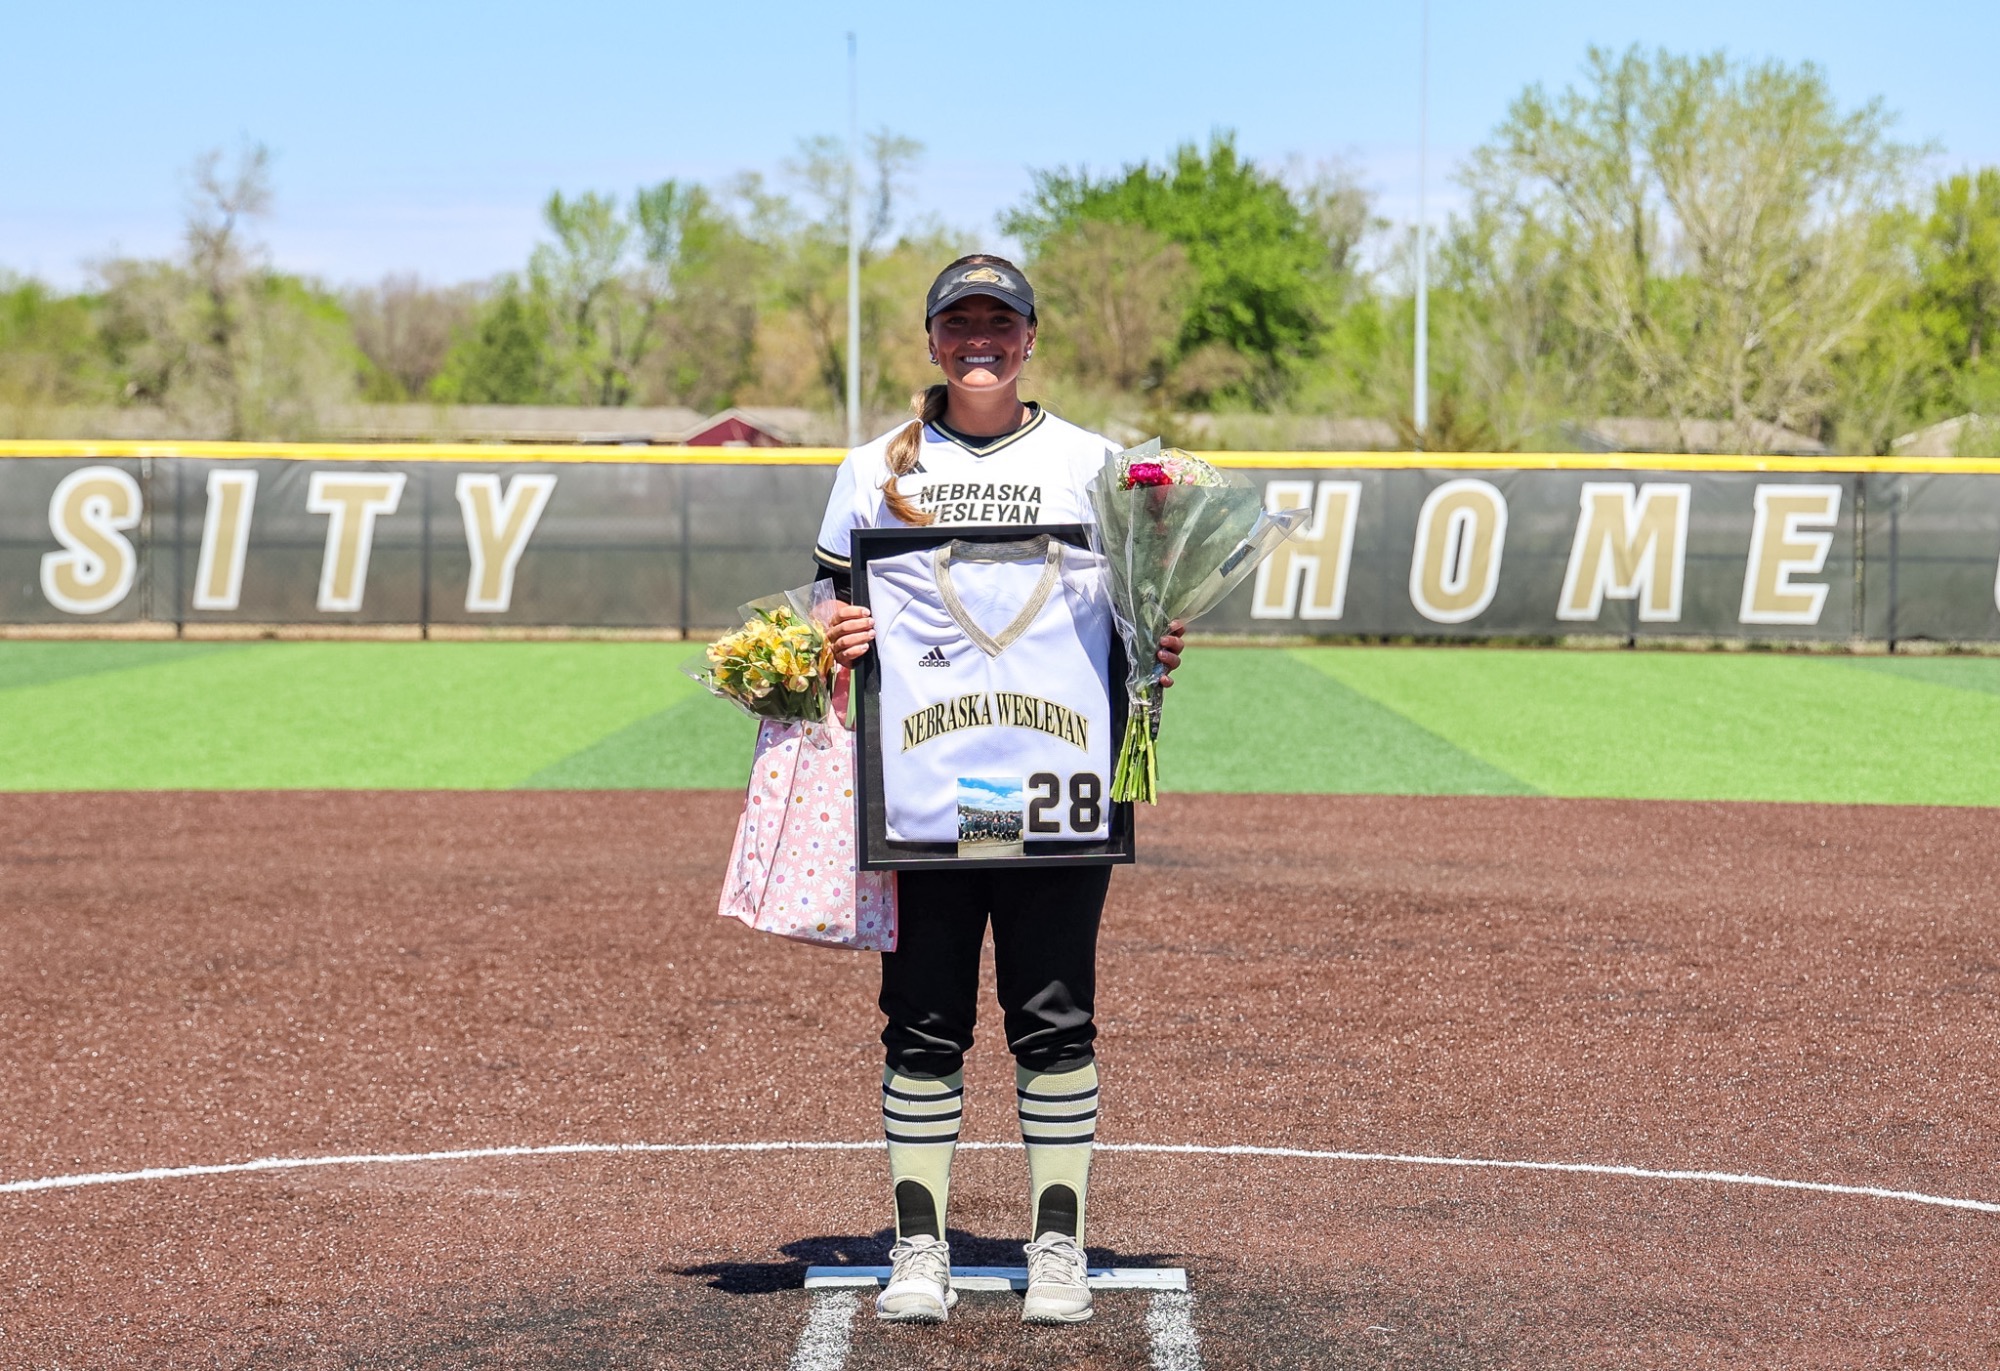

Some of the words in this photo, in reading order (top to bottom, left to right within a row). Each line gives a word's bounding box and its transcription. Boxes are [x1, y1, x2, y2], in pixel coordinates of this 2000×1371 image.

[920, 482, 1042, 505] NEBRASKA
[40, 465, 558, 613] SITY
[1250, 479, 1843, 624] HOME
[918, 658, 951, 668] adidas
[902, 691, 994, 752] NEBRASKA
[995, 691, 1089, 753] WESLEYAN
[1027, 772, 1102, 834] 28
